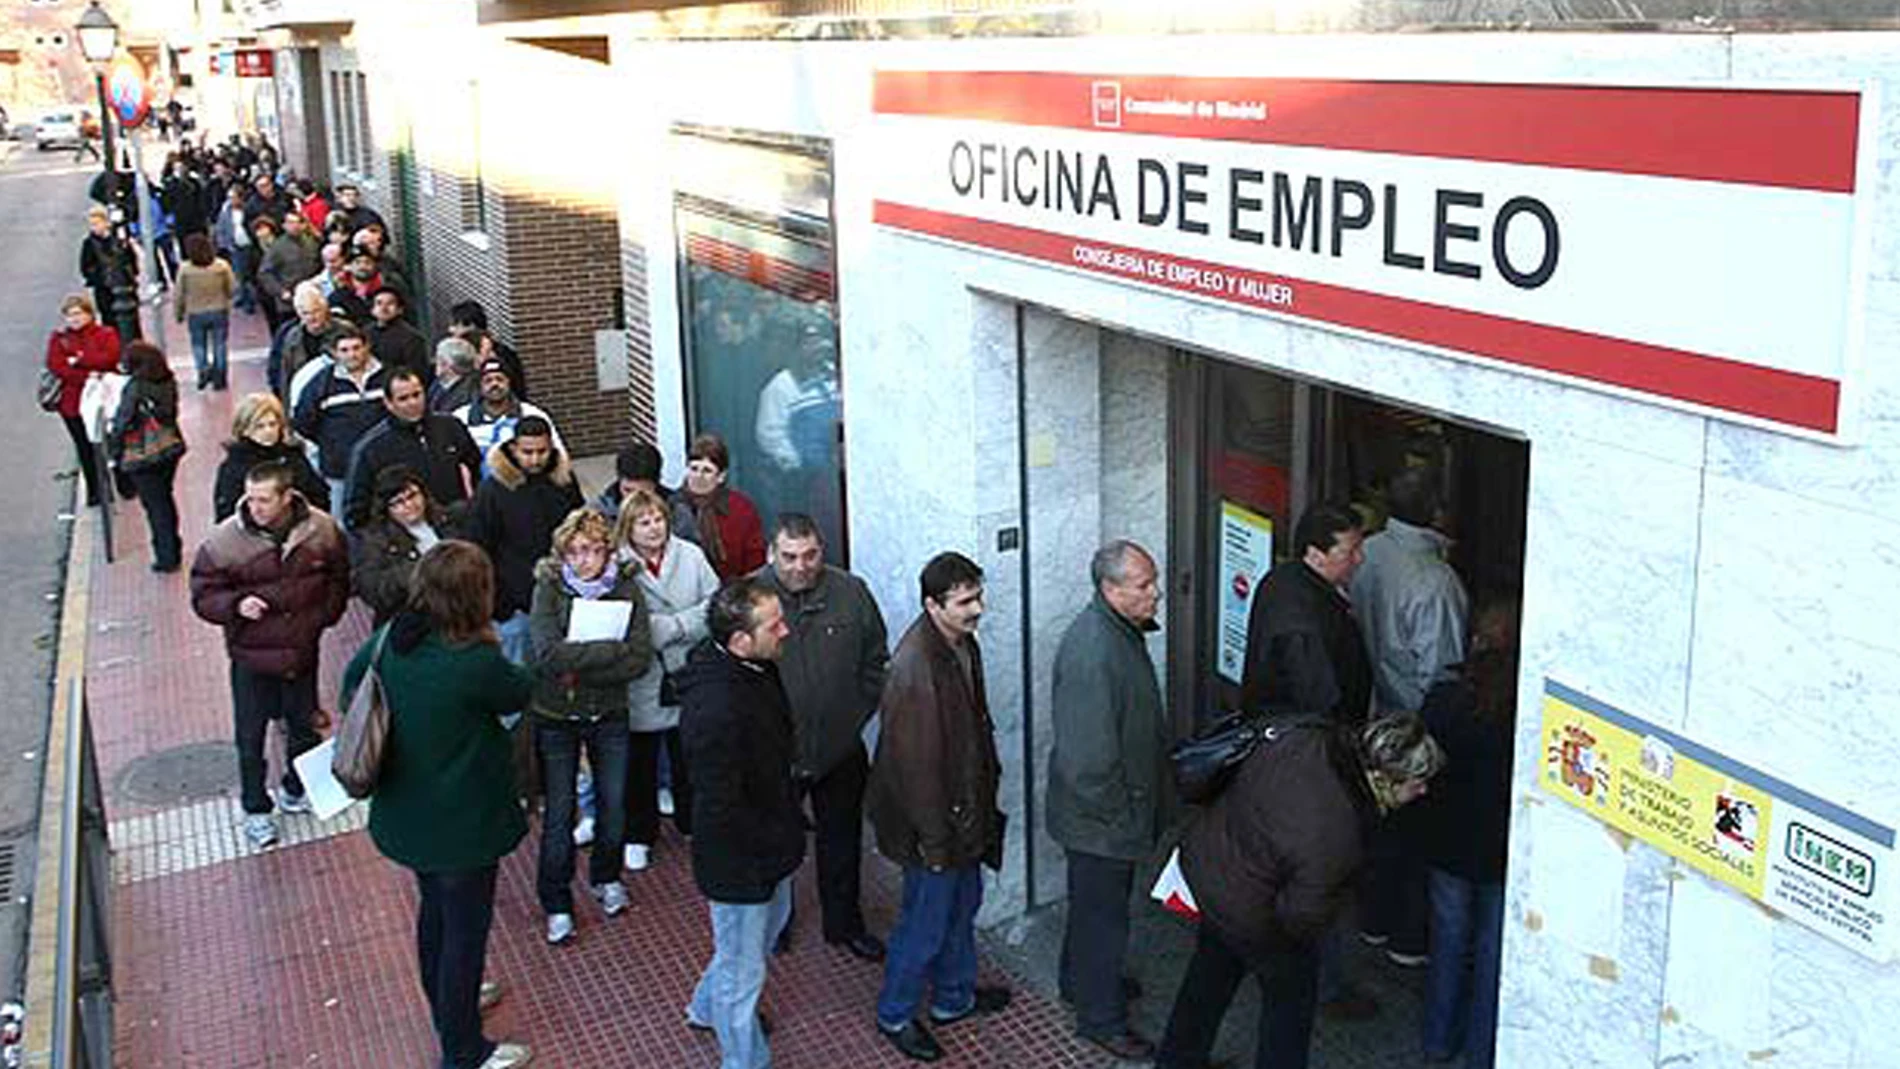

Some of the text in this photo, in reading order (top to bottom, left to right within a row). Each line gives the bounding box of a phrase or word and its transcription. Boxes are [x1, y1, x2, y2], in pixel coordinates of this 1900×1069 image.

[1124, 97, 1266, 120] Comunidad de Madrid
[948, 139, 1561, 290] OFICINA DE EMPLEO
[1147, 259, 1166, 279] DE
[1167, 264, 1224, 291] EMPLEO
[1225, 275, 1238, 294] Y
[1239, 280, 1292, 304] MUJER
[1620, 768, 1692, 811] MINISTERIO
[1620, 783, 1694, 831] DE TRABAJO
[1628, 806, 1689, 844] ASUNTOS
[1690, 836, 1755, 879] SOCIALES
